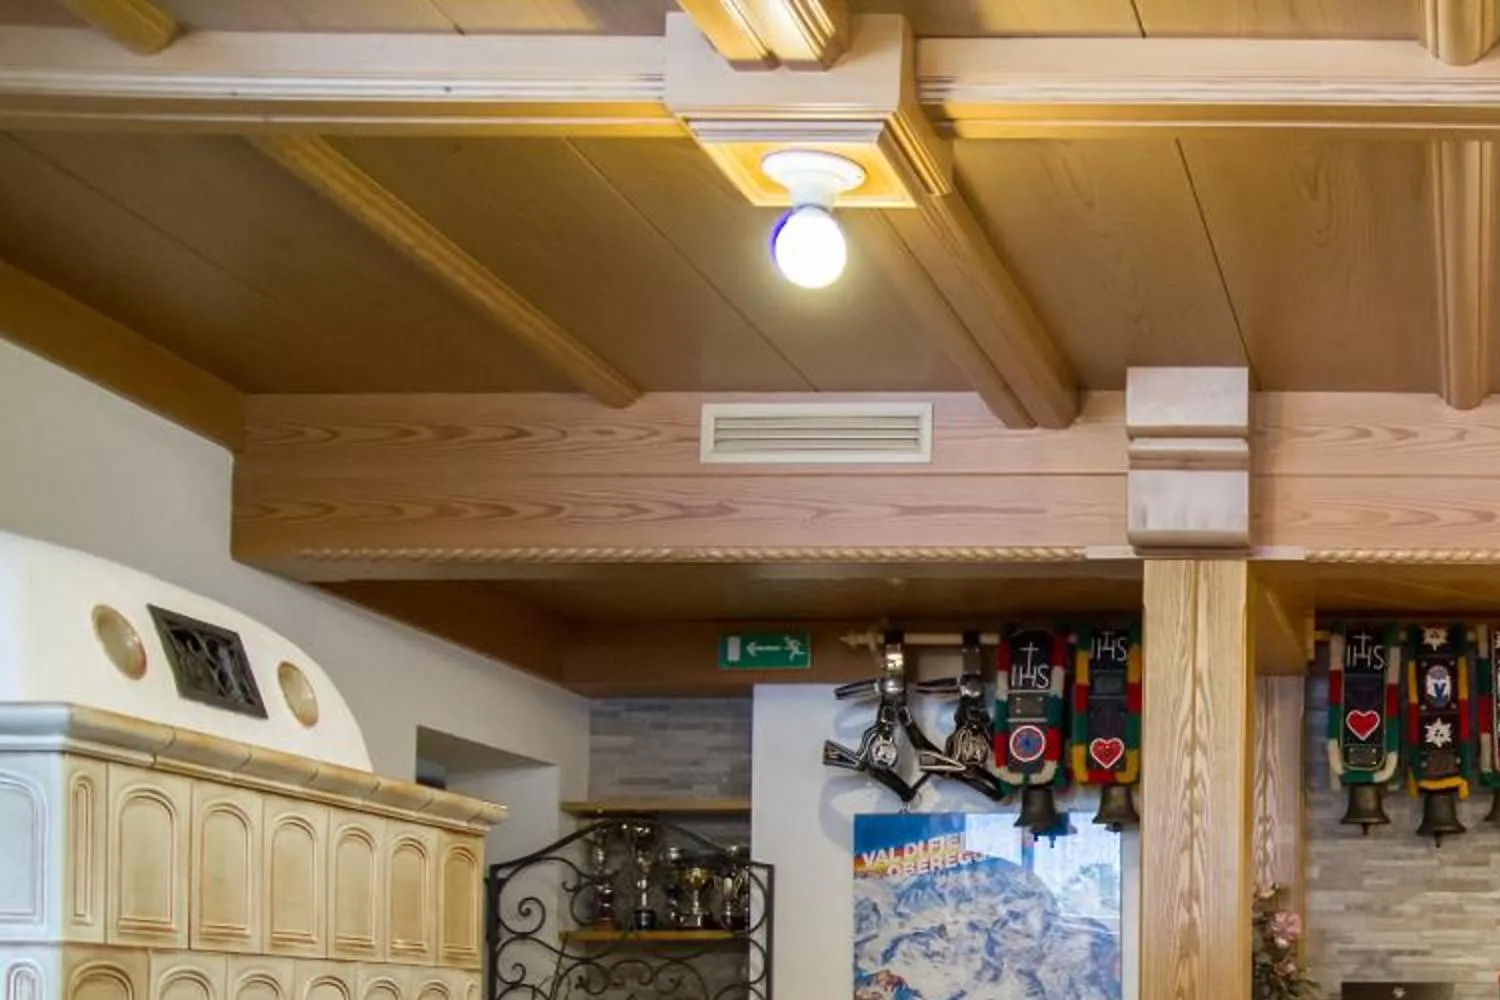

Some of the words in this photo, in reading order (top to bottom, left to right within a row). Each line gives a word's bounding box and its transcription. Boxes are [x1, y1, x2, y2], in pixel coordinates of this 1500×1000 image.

[1346, 642, 1385, 672] IHS
[1011, 661, 1049, 689] IHS
[862, 846, 904, 866] VAL
